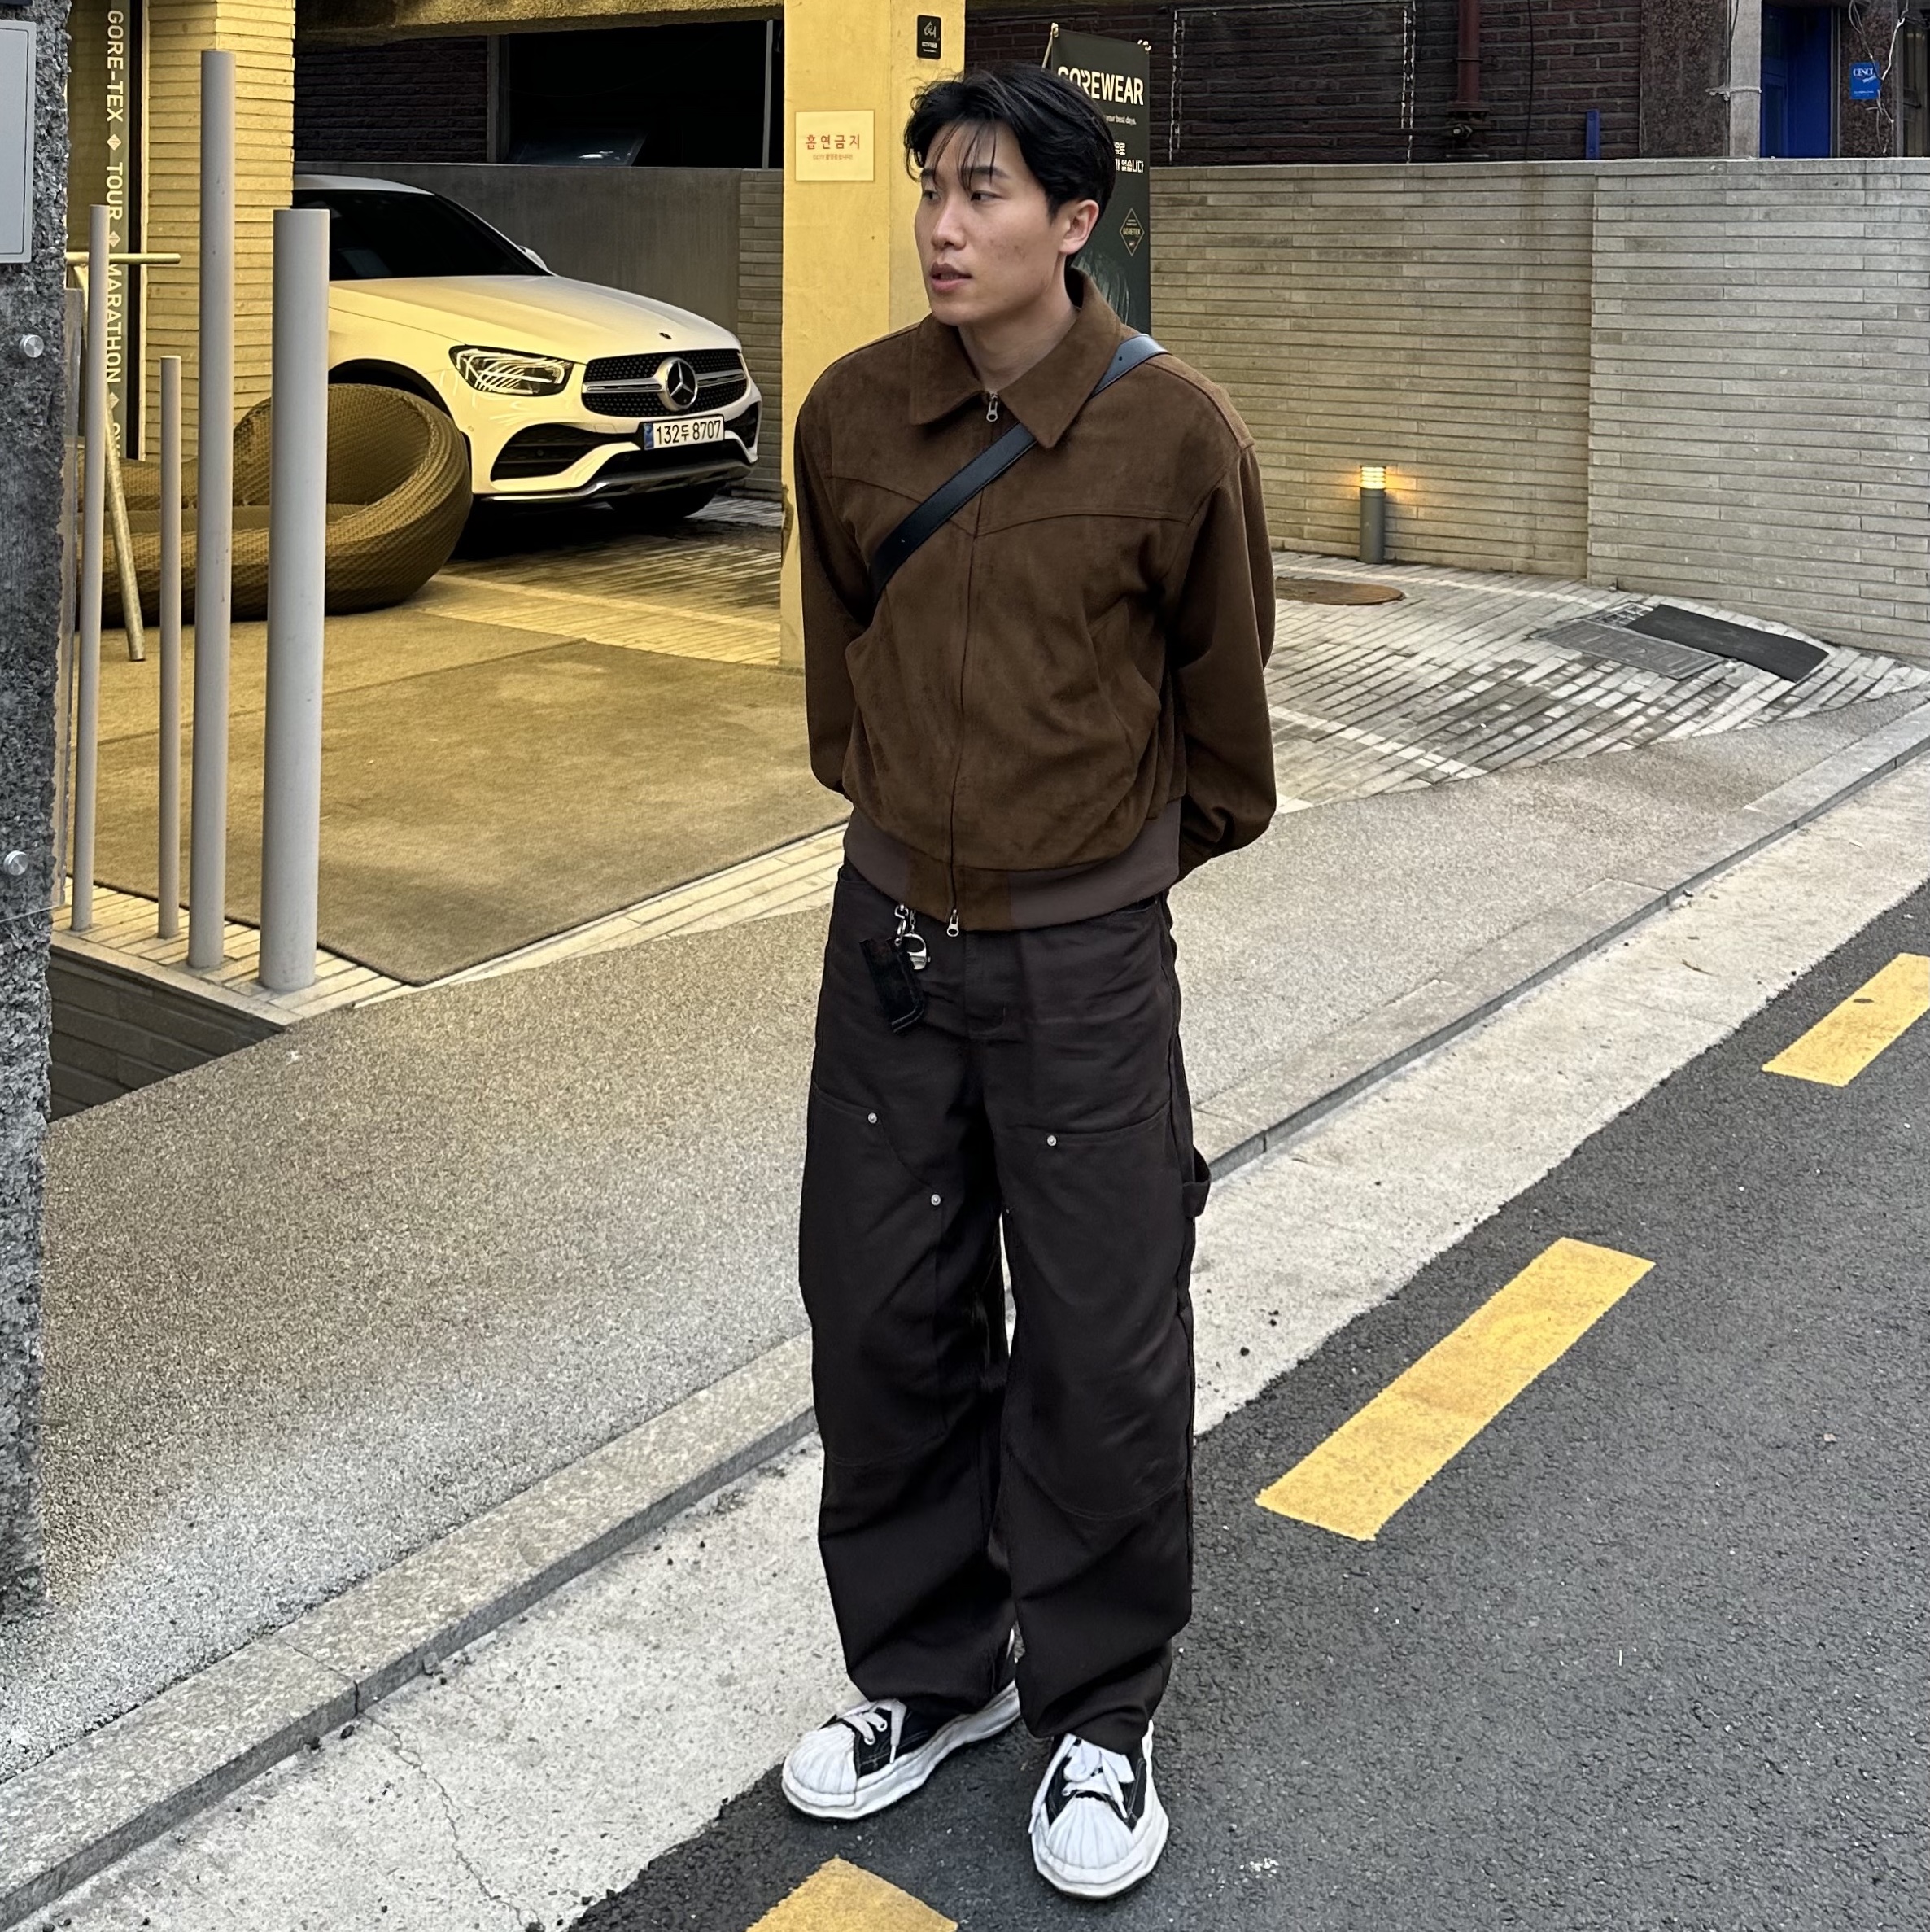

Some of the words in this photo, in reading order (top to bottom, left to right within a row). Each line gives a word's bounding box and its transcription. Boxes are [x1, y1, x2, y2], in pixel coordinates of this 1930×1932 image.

[107, 10, 124, 122] GORE-TEX
[1116, 115, 1125, 124] best
[805, 133, 860, 150] 흡연금지
[106, 162, 123, 221] TOUR
[106, 264, 122, 383] MARATHON
[656, 424, 689, 445] 132두
[692, 420, 721, 440] 8707
